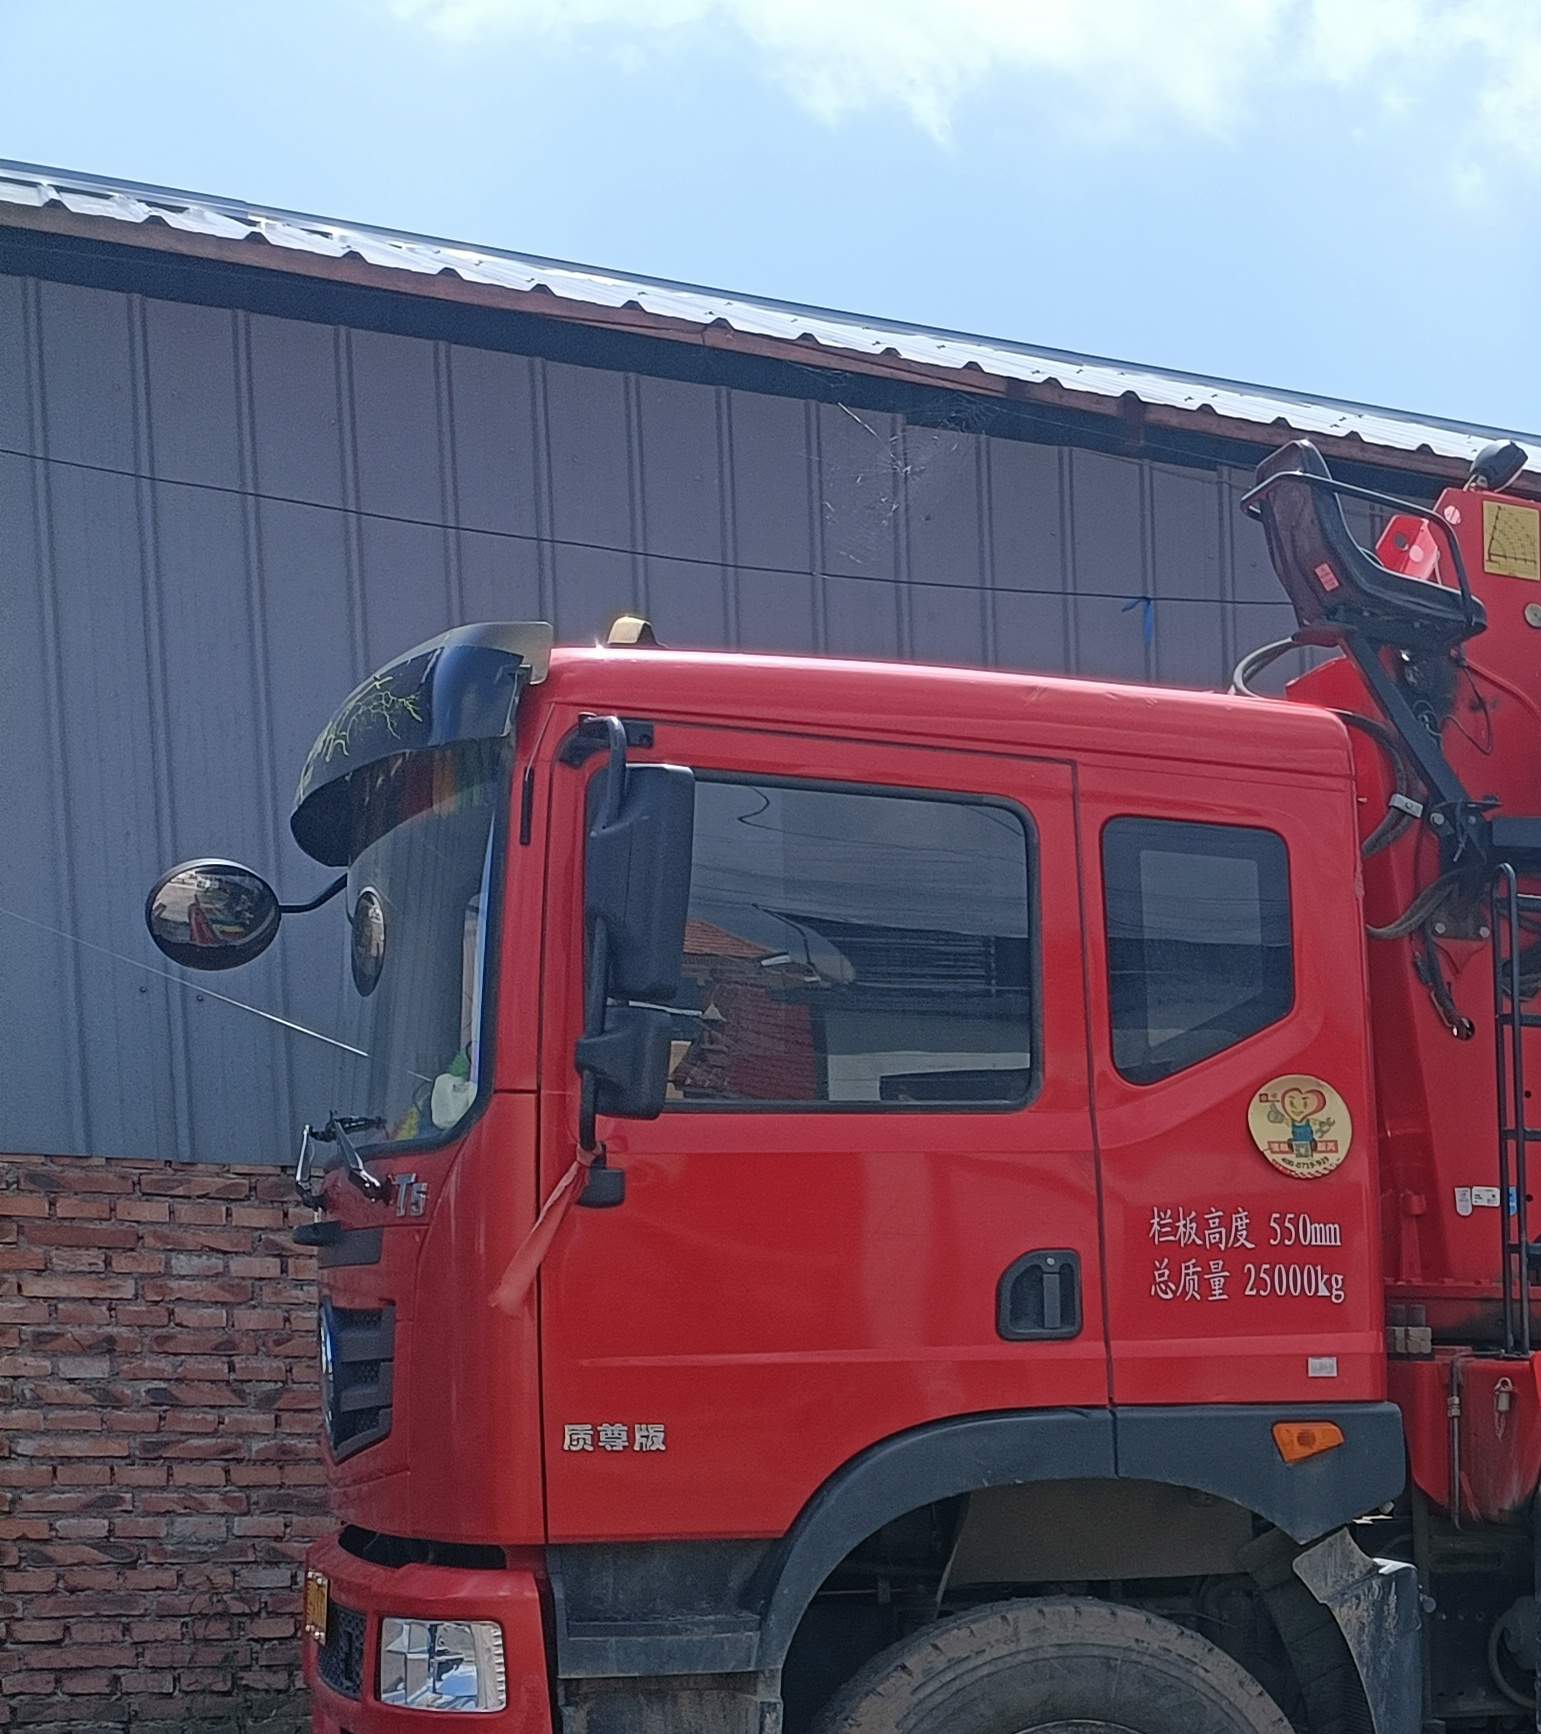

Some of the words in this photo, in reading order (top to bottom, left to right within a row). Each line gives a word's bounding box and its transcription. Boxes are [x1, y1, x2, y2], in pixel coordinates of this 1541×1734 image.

[1149, 1207, 1256, 1251] 栏板高度
[1269, 1213, 1342, 1247] 550mm
[1151, 1258, 1230, 1302] 总质量
[1243, 1263, 1345, 1304] 25000kg
[563, 1423, 667, 1452] 质尊版
